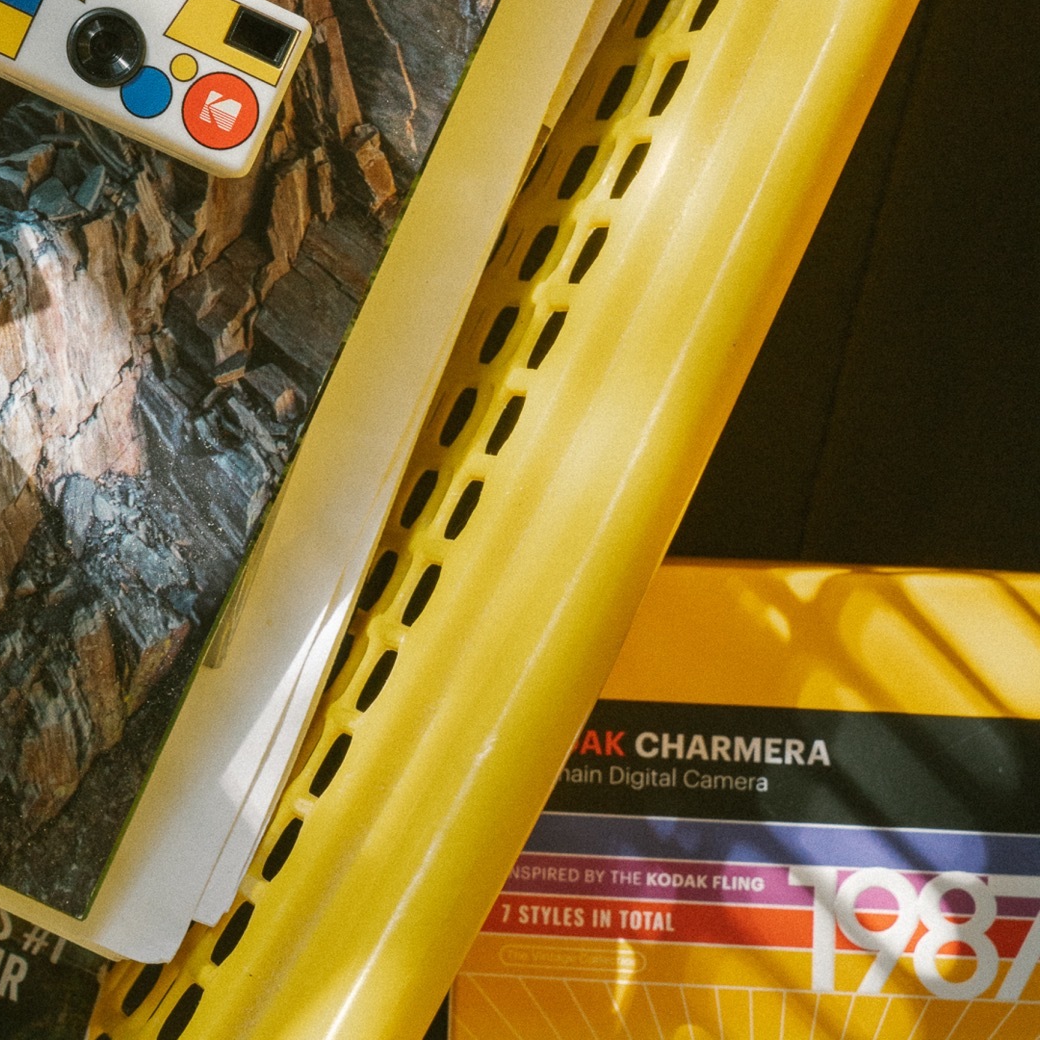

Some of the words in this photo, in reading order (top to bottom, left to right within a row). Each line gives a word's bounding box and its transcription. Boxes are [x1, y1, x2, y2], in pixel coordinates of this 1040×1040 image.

[634, 731, 832, 767] CHARMERA
[609, 765, 677, 791] Digital
[683, 768, 769, 793] Camera
[510, 865, 580, 883] NSPIRED
[584, 868, 605, 884] BY
[611, 869, 642, 886] THE
[646, 872, 708, 889] KODAK
[712, 875, 766, 892] FLING
[501, 903, 511, 923] 7
[518, 904, 585, 927] STYLES
[592, 908, 612, 928] IN
[619, 909, 675, 932] TOTAL
[788, 865, 1040, 1001] 1987
